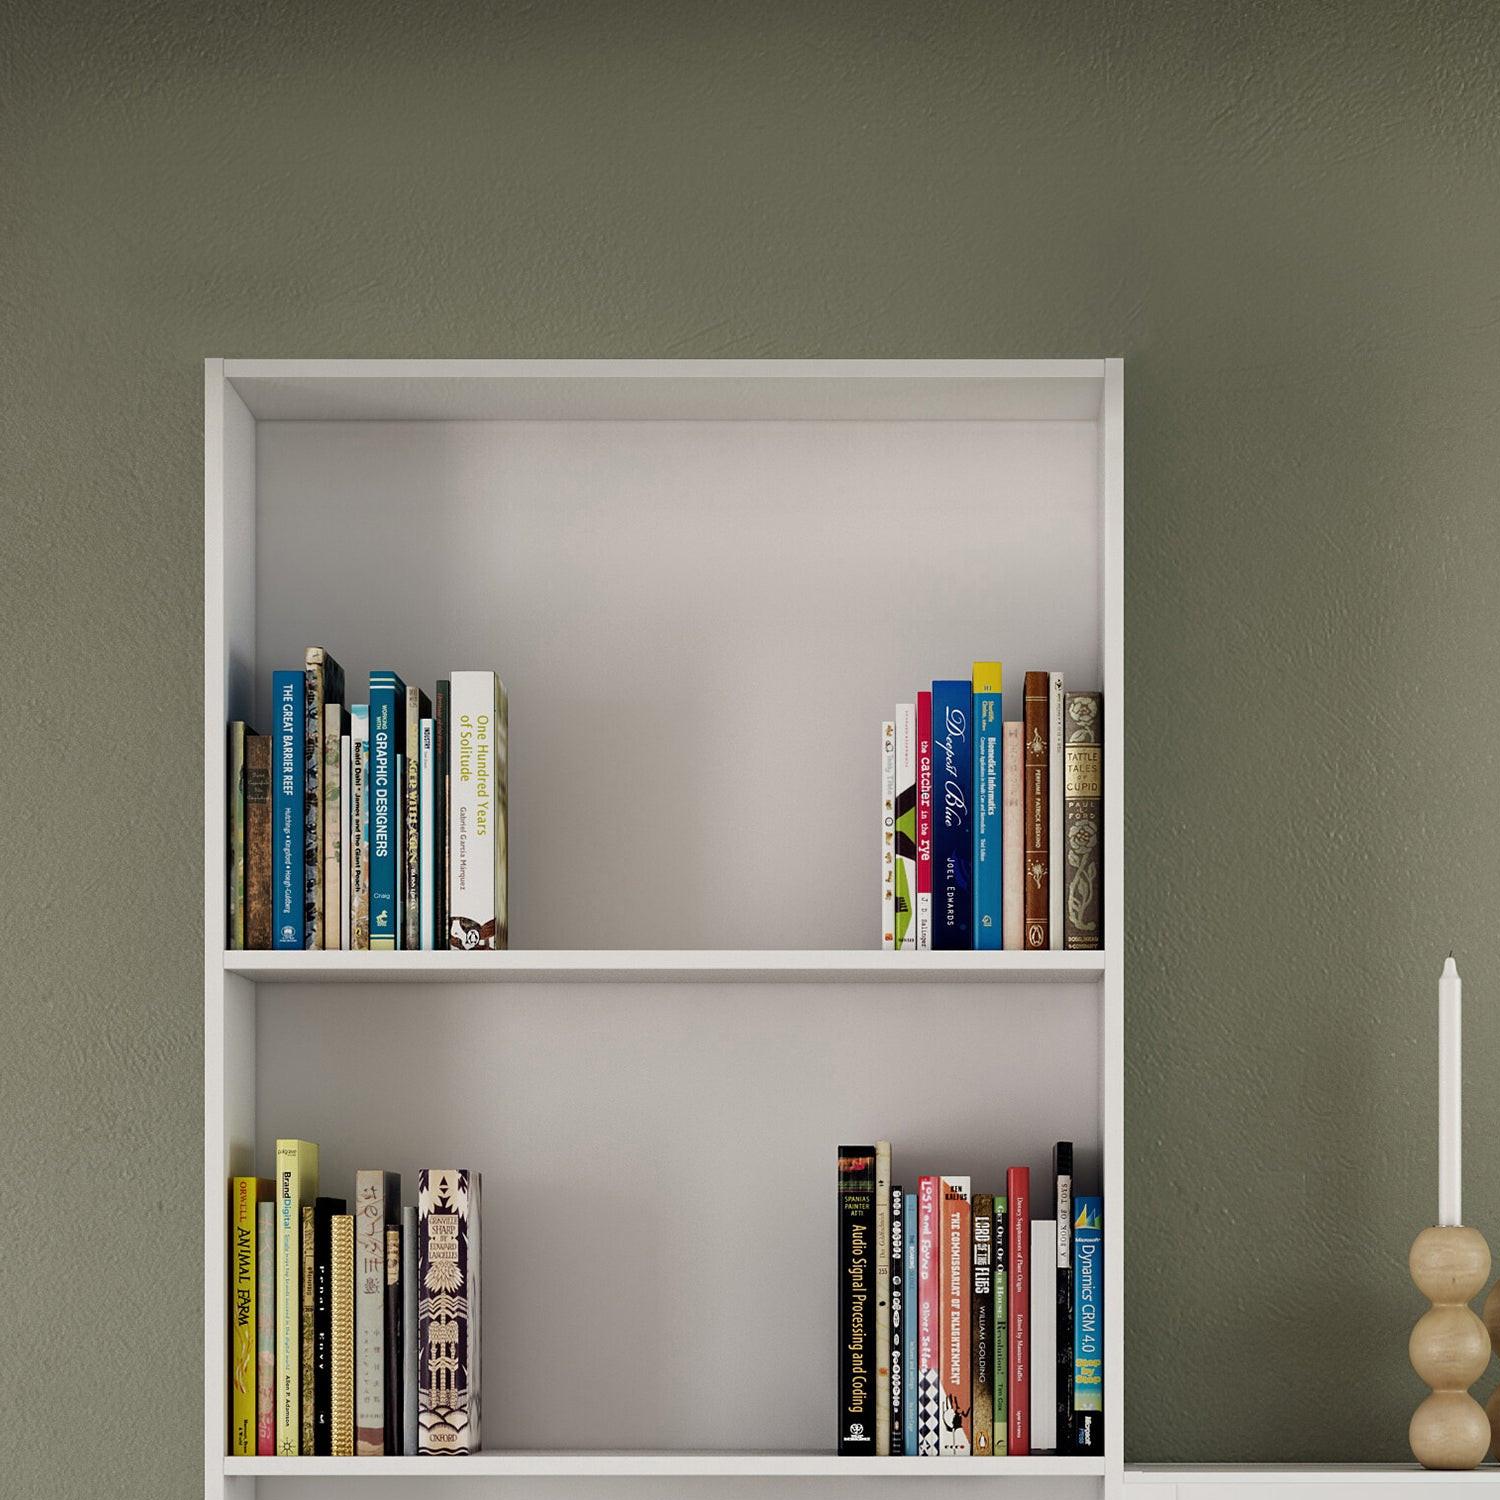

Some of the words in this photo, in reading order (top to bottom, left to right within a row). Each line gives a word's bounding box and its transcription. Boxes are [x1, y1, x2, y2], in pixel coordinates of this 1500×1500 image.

[283, 684, 293, 702] THE
[283, 704, 293, 733] GREAT
[461, 715, 473, 728] of
[478, 715, 490, 740] One
[283, 735, 293, 773] BARRIER
[461, 731, 473, 782] Solitude
[921, 740, 929, 752] the
[935, 706, 966, 778] Deepest
[988, 737, 996, 776] Biomedical
[376, 732, 388, 786] GRAPHIC
[478, 744, 490, 798] Hundred
[1068, 753, 1099, 761] TATTLE
[1068, 764, 1098, 773] TALES
[283, 775, 293, 797] REEF
[920, 757, 931, 807] catcher
[988, 777, 996, 815] Informatics
[1035, 770, 1043, 795] PERFUME
[1067, 782, 1098, 791] CUPID
[478, 802, 490, 836] Years
[921, 810, 929, 819] in
[945, 781, 967, 829] Blue
[1035, 797, 1043, 822] PATRICK
[376, 789, 388, 858] DESIGNERS
[921, 823, 929, 836] the
[919, 840, 930, 861] rye
[947, 858, 955, 879] JOEL
[947, 887, 955, 926] EDWARDS
[919, 919, 928, 948] Salinger
[239, 1181, 247, 1222] ORWELL
[283, 1171, 292, 1229] BrandDigital
[1060, 1183, 1068, 1205] TOYS
[951, 1212, 960, 1229] THE
[975, 1216, 990, 1242] LORD
[1016, 1218, 1024, 1250] Supplements
[853, 1224, 867, 1256] Audio
[237, 1226, 251, 1284] ANIMAL
[951, 1231, 960, 1297] COMMISSARIAT
[997, 1247, 1004, 1263] OF
[1016, 1259, 1024, 1273] Plant
[848, 1258, 867, 1291] Signal
[1016, 1274, 1024, 1293] Origin
[1078, 1244, 1096, 1300] Dynamics
[237, 1289, 251, 1327] FARM
[921, 1302, 930, 1332] Oliver
[951, 1299, 960, 1309] OF
[1081, 1304, 1096, 1332] CRM
[848, 1295, 866, 1350] Processing
[951, 1311, 960, 1386] ENLIGHTENMENT
[1081, 1334, 1096, 1353] 4.0
[853, 1353, 867, 1373] and
[848, 1376, 866, 1413] Coding
[1084, 1416, 1092, 1446] Microsoft
